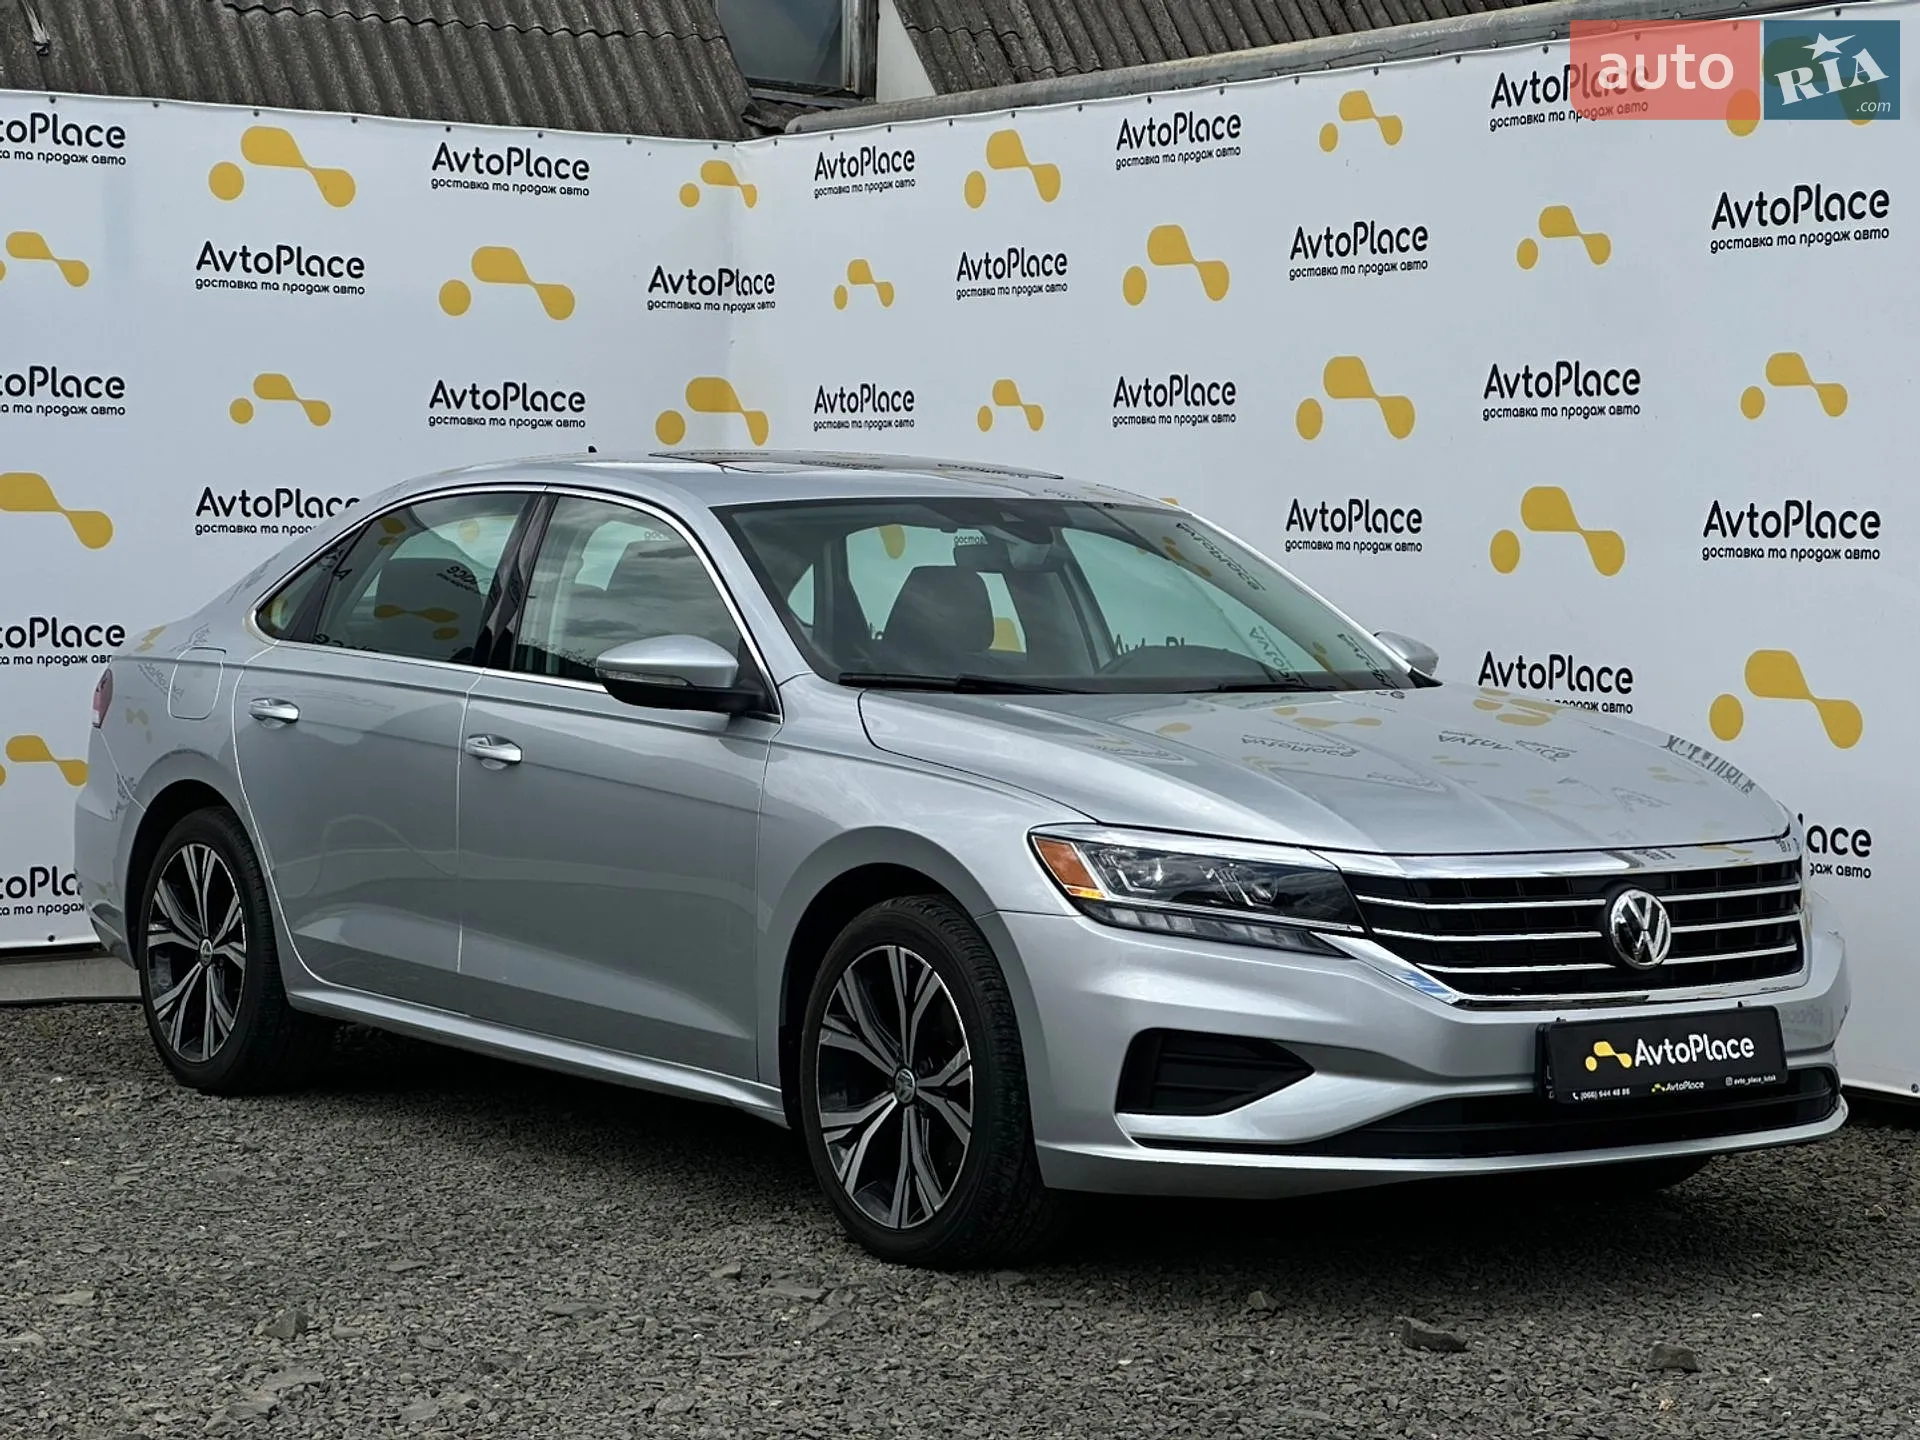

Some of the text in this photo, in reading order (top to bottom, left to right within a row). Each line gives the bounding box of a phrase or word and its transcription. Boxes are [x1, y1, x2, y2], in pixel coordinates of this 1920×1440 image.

[1116, 110, 1242, 151] AvtoPlace
[1489, 112, 1546, 133] доставка
[1547, 110, 1566, 123] та
[13, 150, 34, 161] та
[37, 151, 89, 166] продаж
[90, 154, 127, 166] авто
[431, 141, 590, 182] AvtoPlace
[814, 145, 915, 182] AvtoPlace
[1115, 146, 1242, 171] доставка та продаж авто
[430, 178, 590, 197] доставка та продаж авто
[814, 178, 916, 200] доставка та продаж авто
[1711, 183, 1890, 231] AvtoPlace
[1289, 220, 1429, 261] AvtoPlace
[1710, 227, 1890, 255] доставка та продаж авто
[195, 240, 365, 280] AvtoPlace
[956, 246, 1068, 283] AvtoPlace
[1289, 259, 1429, 282] доставка та продаж авто
[194, 278, 366, 296] доставка та продаж авто
[647, 265, 776, 297] AvtoPlace
[955, 282, 1068, 301] доставка та продаж авто
[646, 299, 776, 315] доставка та продаж авто
[1112, 373, 1237, 409] AvtoPlace
[1483, 360, 1641, 400] AvtoPlace
[428, 379, 586, 414] AvtoPlace
[813, 383, 915, 415] AvtoPlace
[12, 404, 33, 414] та
[35, 404, 88, 418] продаж
[90, 405, 126, 416] авто
[428, 415, 586, 430] доставка та продаж авто
[1112, 413, 1237, 428] доставка та продаж авто
[1482, 404, 1641, 422] доставка та продаж авто
[813, 418, 915, 433] доставка та продаж авто
[1285, 498, 1423, 535] AvtoPlace
[1702, 499, 1882, 540] AvtoPlace
[194, 523, 258, 536] доставка
[259, 524, 279, 535] та
[1284, 539, 1423, 555] доставка та продаж авто
[1701, 546, 1881, 563] доставка та продаж авто
[13, 655, 34, 665] та
[36, 654, 89, 668] продаж
[1476, 650, 1635, 695] AvtoPlace
[1601, 702, 1634, 715] авто
[1835, 864, 1872, 879] авто
[13, 905, 34, 916] та
[1634, 1033, 1755, 1067] AvtoPlace
